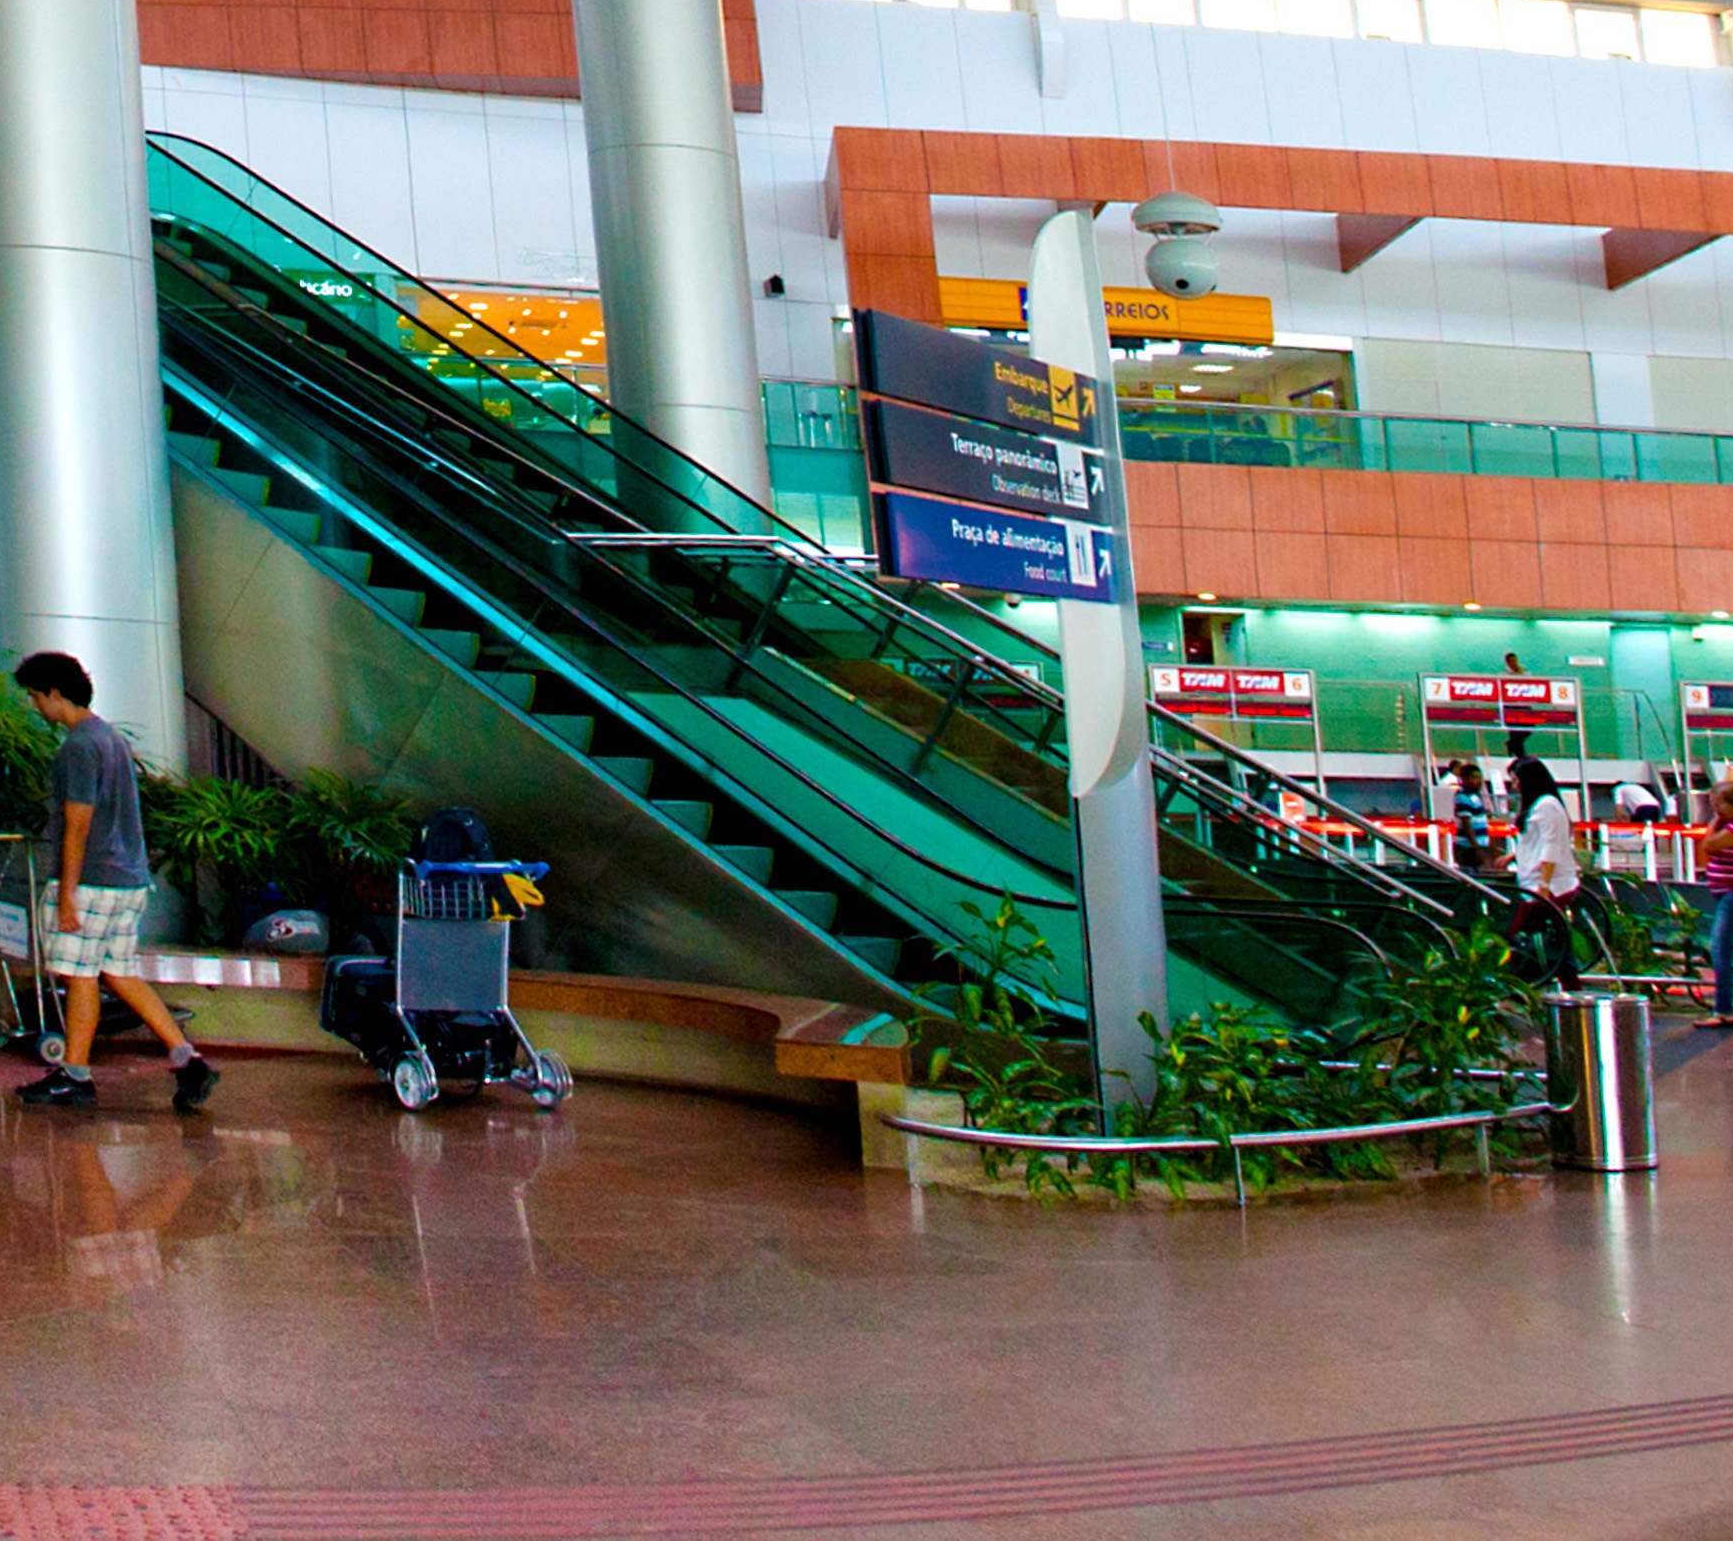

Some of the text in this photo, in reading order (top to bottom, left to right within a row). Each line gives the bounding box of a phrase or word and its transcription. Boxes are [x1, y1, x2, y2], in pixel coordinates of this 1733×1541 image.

[1104, 301, 1169, 321] RREIOS
[994, 361, 1049, 396] Embarque
[950, 432, 1057, 476] Terraço panorâmico
[991, 473, 1061, 504] Observation deck
[951, 517, 1065, 559] Praça de alimentação
[1023, 560, 1067, 583] Food court
[1160, 672, 1303, 692] 5 TAM TAM 6
[1431, 681, 1569, 700] 7 TAM TAM 8
[1691, 689, 1702, 704] 9
